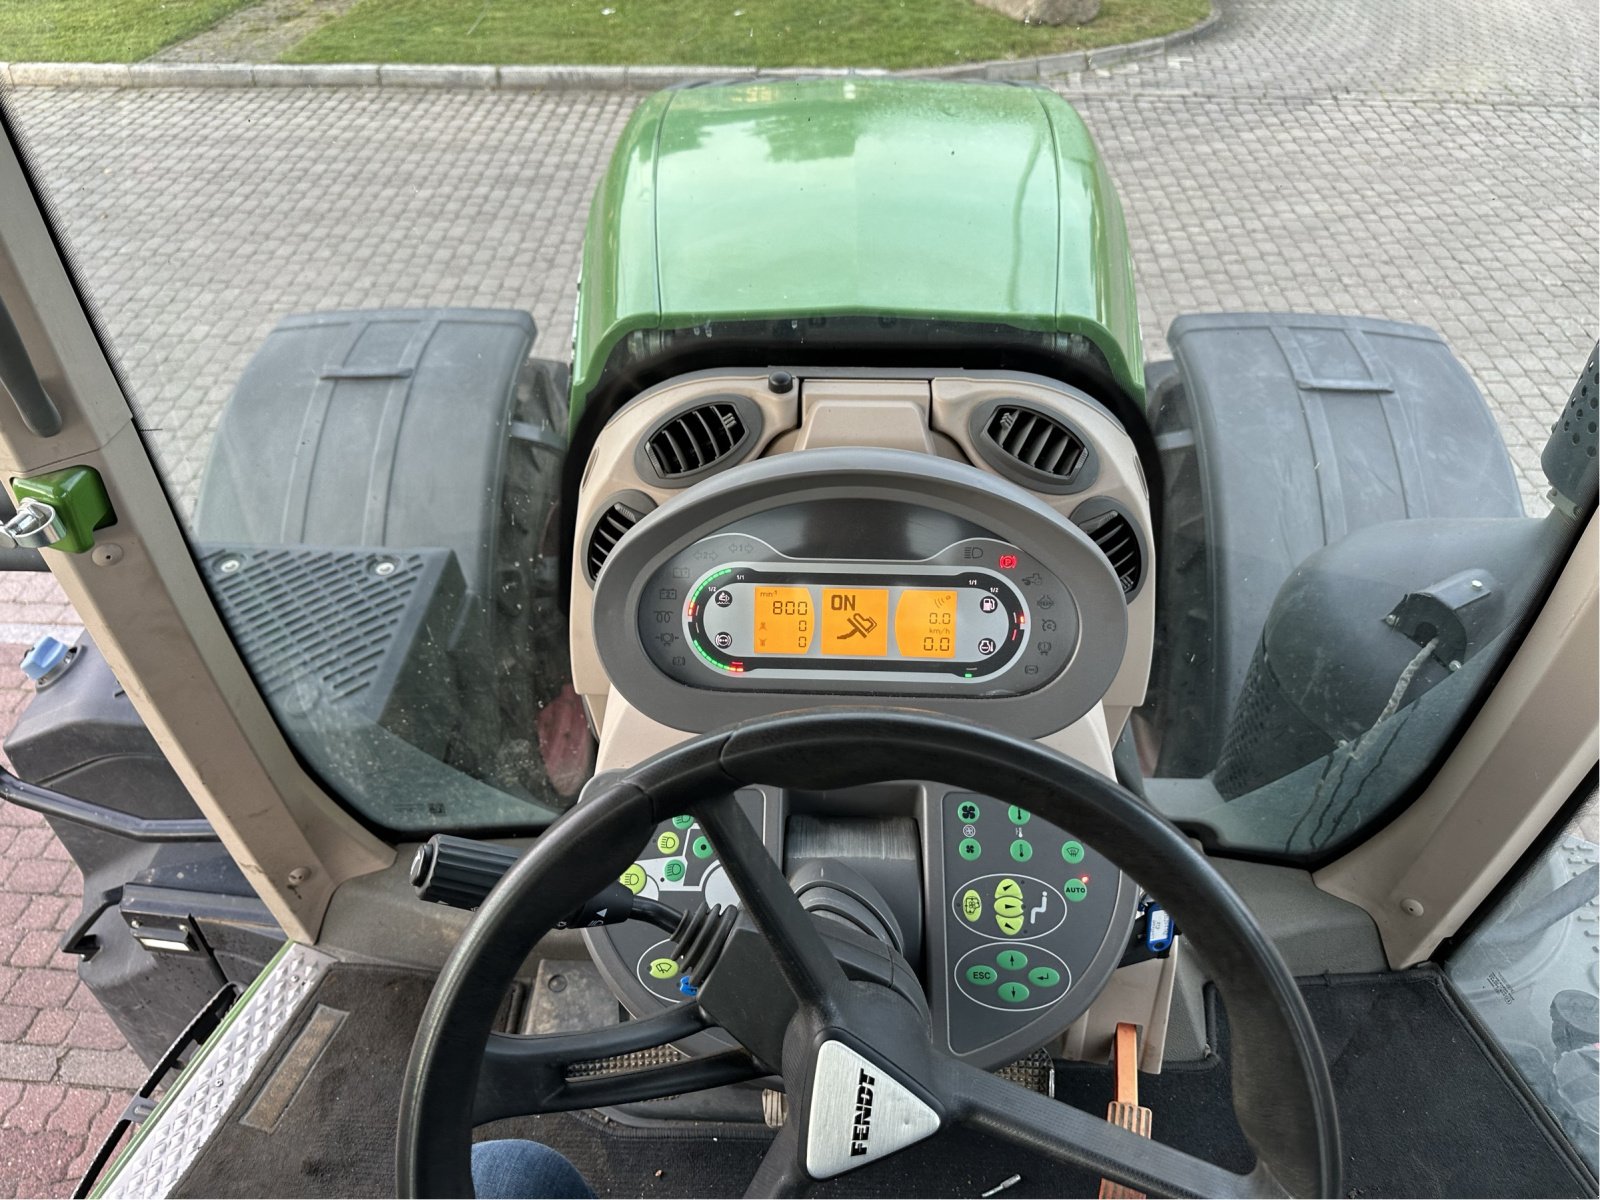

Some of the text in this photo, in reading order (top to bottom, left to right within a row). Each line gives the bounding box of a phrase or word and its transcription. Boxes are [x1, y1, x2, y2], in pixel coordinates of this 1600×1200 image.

[772, 600, 808, 615] 800
[830, 594, 856, 611] ON
[798, 620, 806, 632] 0
[929, 612, 950, 625] 0.0
[798, 636, 806, 648] 0
[924, 637, 950, 652] 0.0
[850, 1068, 875, 1156] FENDT
